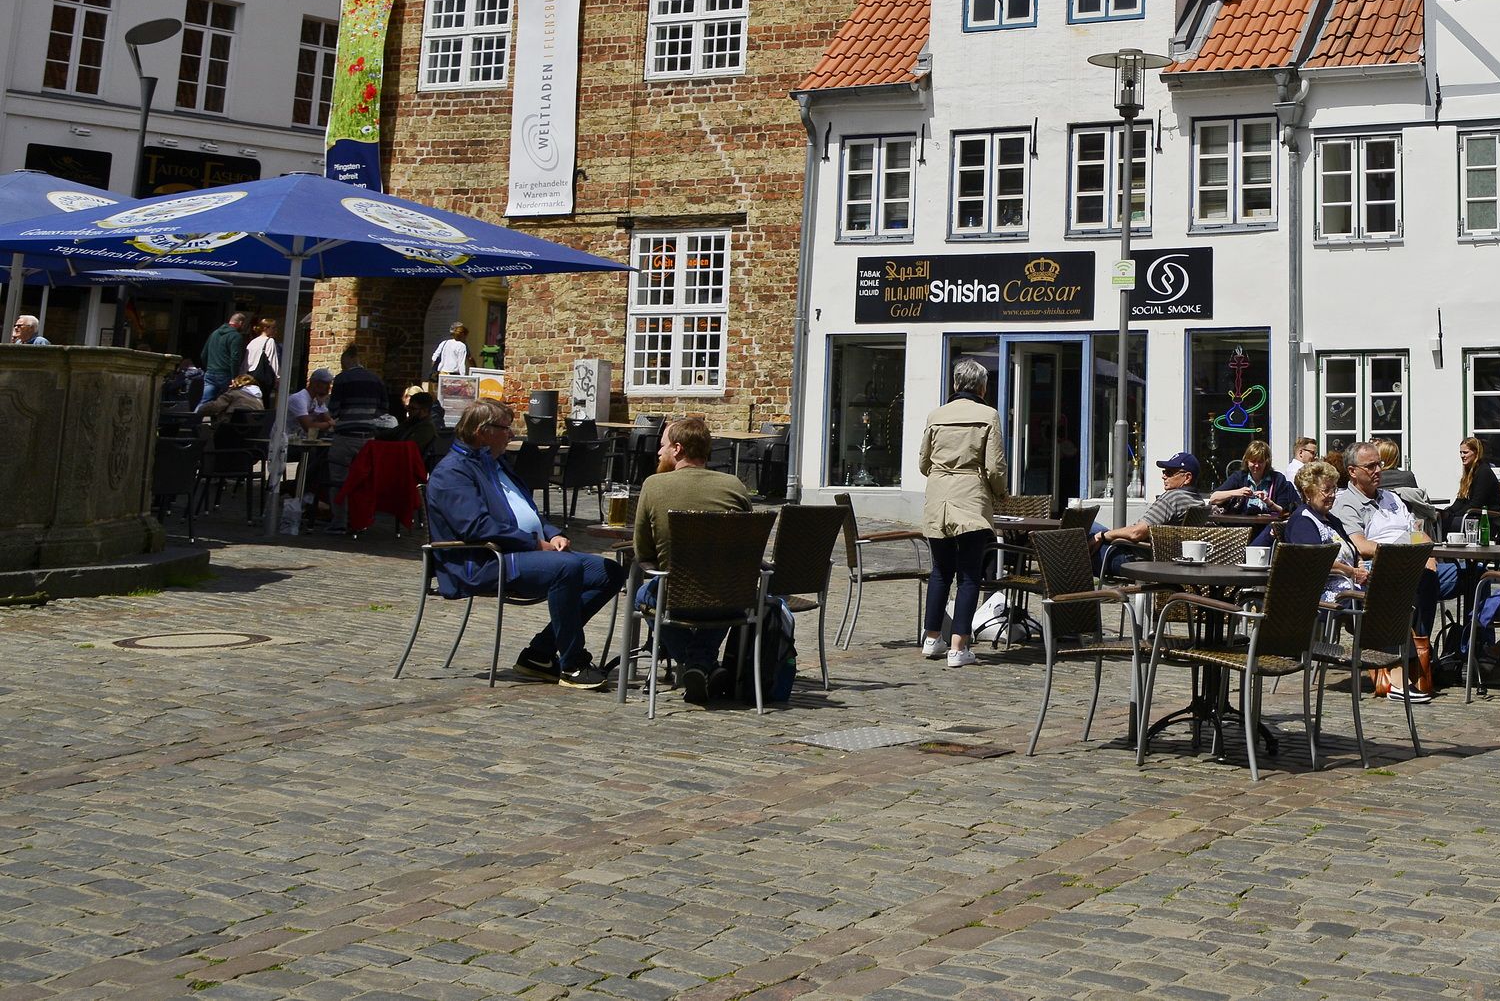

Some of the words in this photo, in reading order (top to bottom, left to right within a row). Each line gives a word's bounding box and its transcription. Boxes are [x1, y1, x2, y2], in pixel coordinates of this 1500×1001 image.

[538, 63, 554, 150] WELTLADEN
[514, 180, 528, 189] Fair
[529, 179, 568, 190] gehandelte
[522, 190, 547, 199] Waren
[515, 199, 567, 210] Nordermarkt.
[859, 270, 881, 278] TABAK
[859, 279, 880, 287] KOHLE
[884, 284, 930, 302] ALAJAMY
[929, 279, 1000, 304] Shisha
[1003, 279, 1081, 303] Caesar
[890, 302, 922, 318] Gold
[1002, 307, 1081, 317] www.caesar-shisha.com
[1131, 305, 1164, 316] SOCIAL
[1167, 303, 1202, 314] SMOKE
